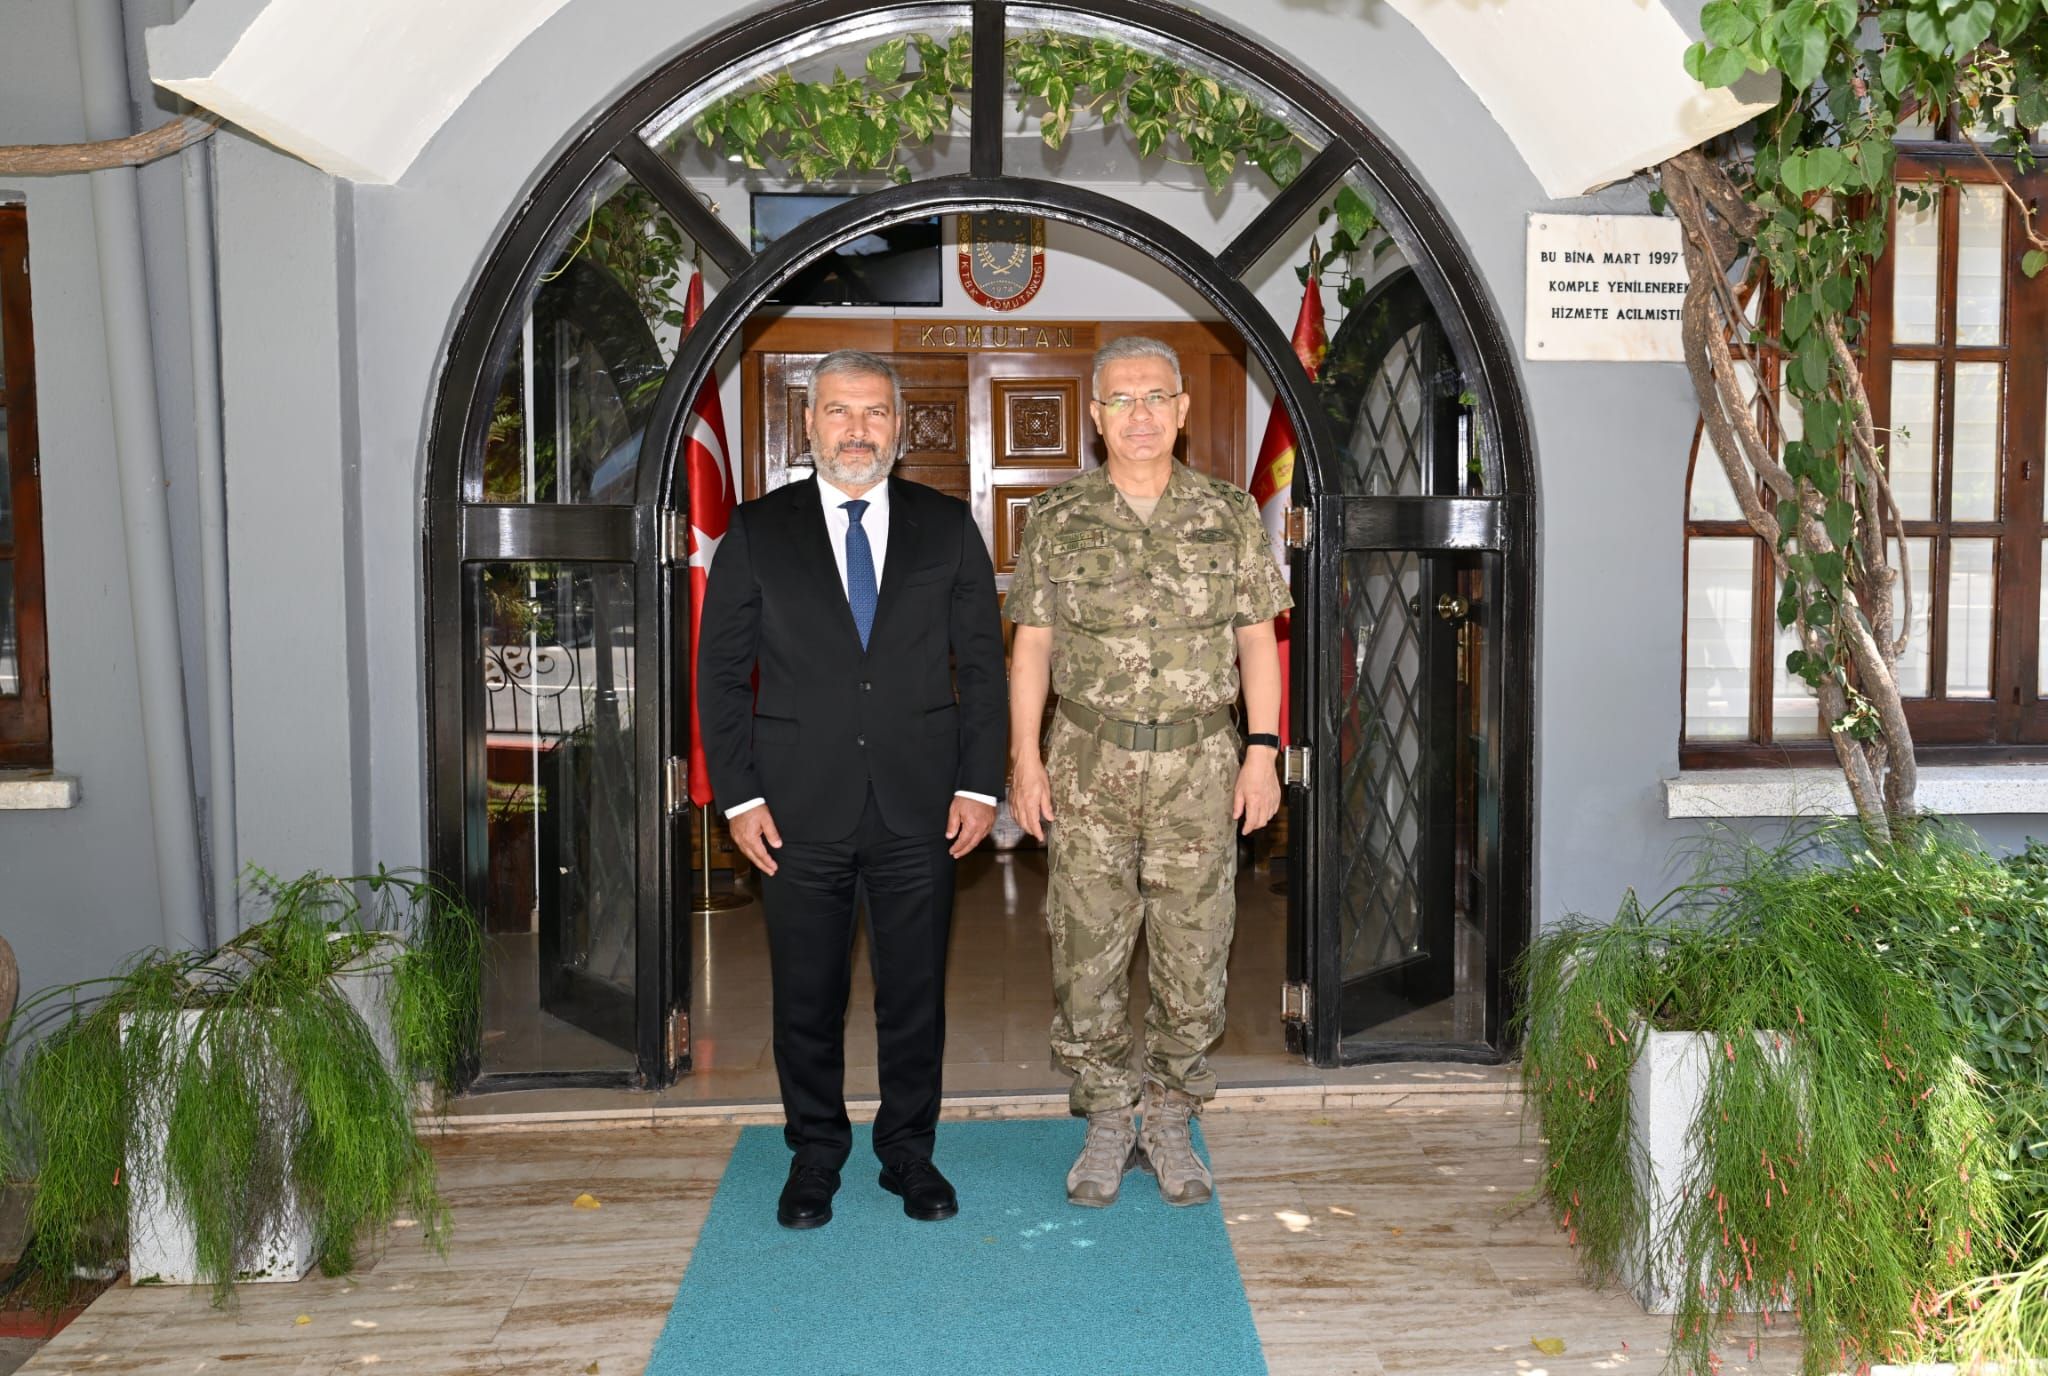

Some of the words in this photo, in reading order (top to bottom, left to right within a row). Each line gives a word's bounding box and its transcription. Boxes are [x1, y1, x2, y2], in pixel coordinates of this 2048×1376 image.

[1541, 251, 1556, 263] BU
[1603, 252, 1641, 265] MART
[1549, 280, 1599, 293] KOMPLE
[1551, 305, 1609, 320] HİZMETE
[1616, 308, 1684, 321] ACILMISTI
[921, 326, 1073, 348] KOMUTAN
